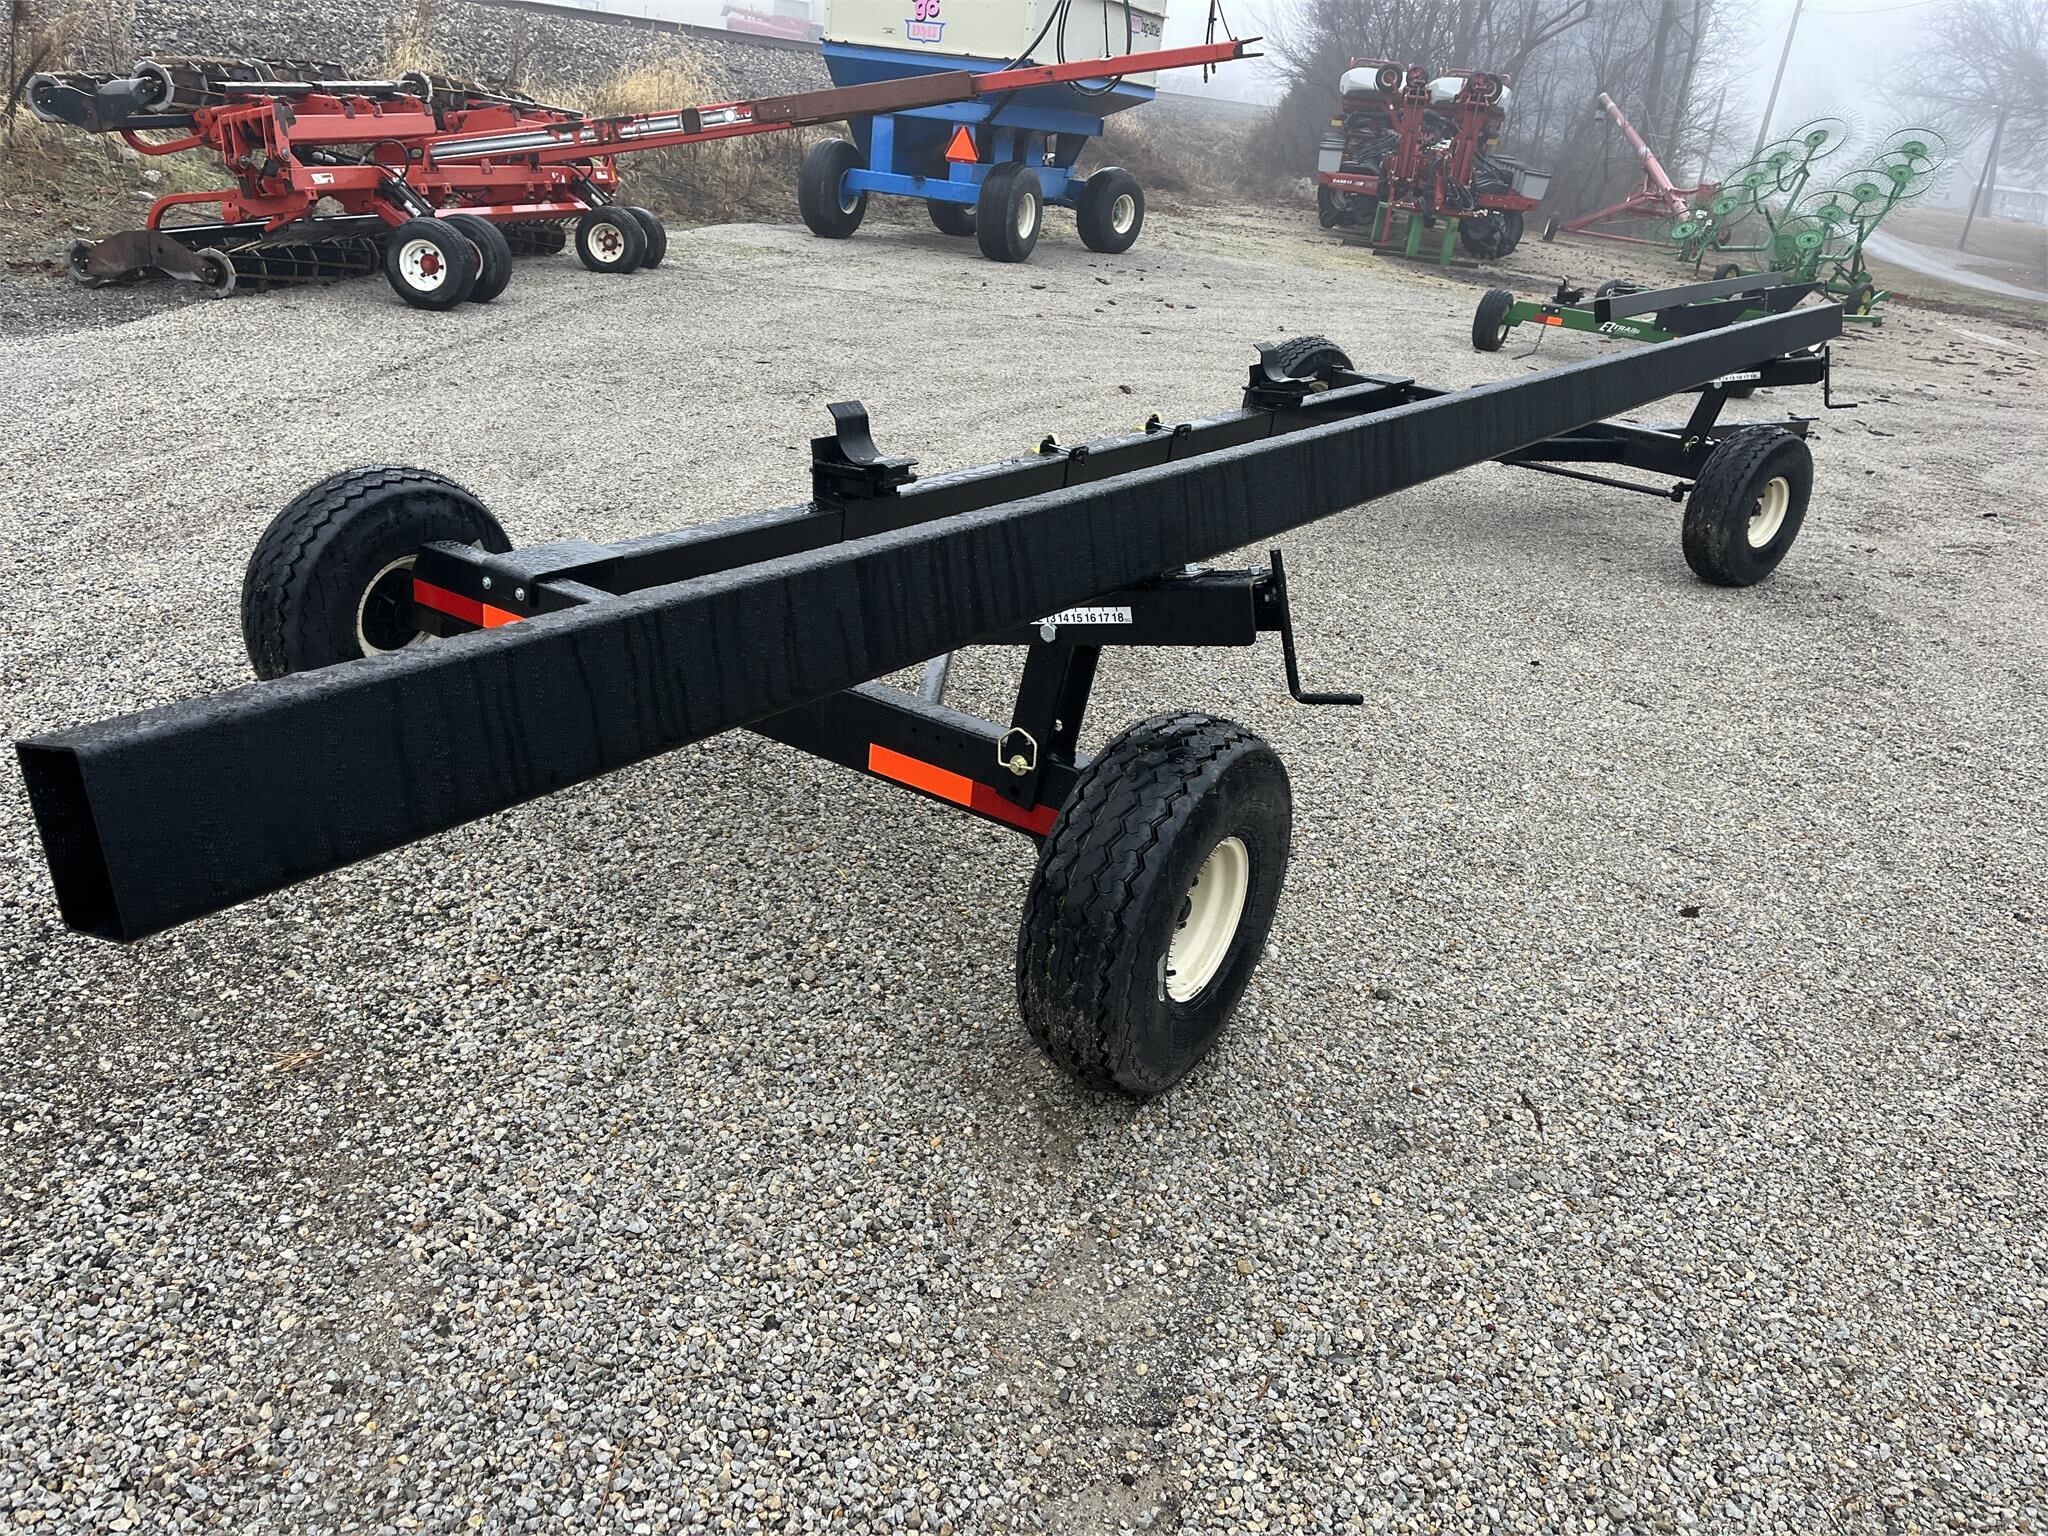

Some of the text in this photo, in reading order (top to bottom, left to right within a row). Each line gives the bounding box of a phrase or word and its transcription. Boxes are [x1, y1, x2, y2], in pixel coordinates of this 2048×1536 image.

[1059, 614, 1069, 623] 14
[1071, 613, 1083, 623] 15
[1084, 613, 1097, 623] 16
[1098, 613, 1110, 623] 17
[1111, 612, 1124, 623] 18
